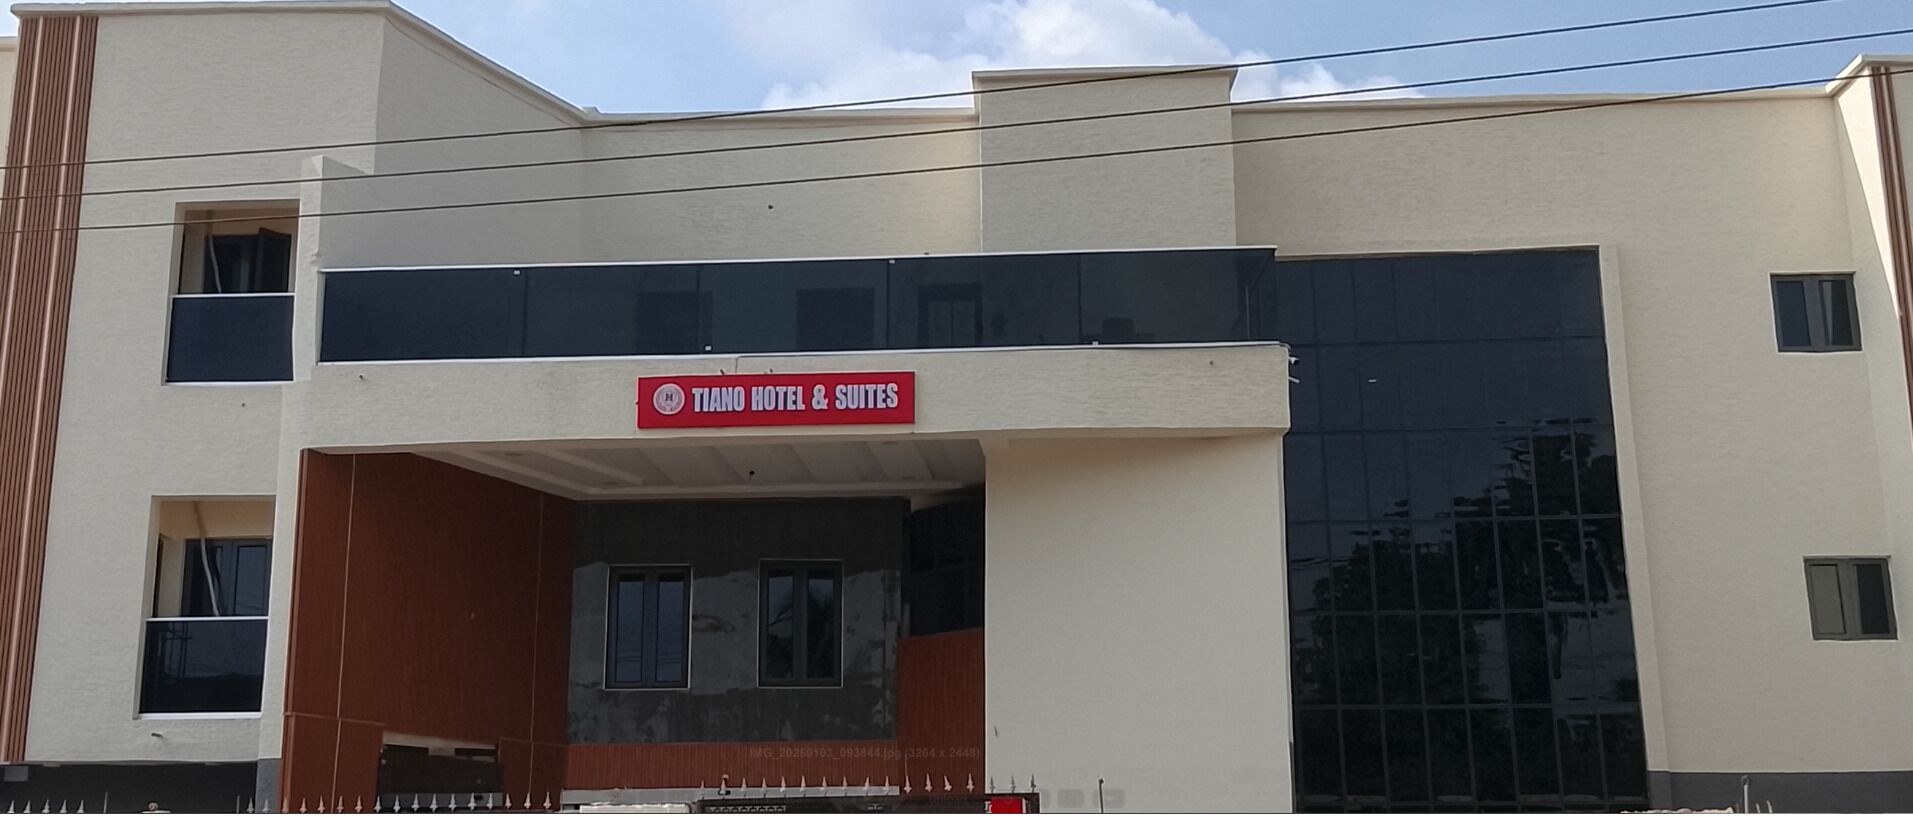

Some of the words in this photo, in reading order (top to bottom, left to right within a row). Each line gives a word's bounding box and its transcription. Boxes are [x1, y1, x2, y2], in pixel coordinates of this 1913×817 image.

[692, 386, 745, 412] TIANO
[751, 385, 806, 411] HOTEL
[812, 384, 829, 410] &
[835, 383, 898, 410] SUITES
